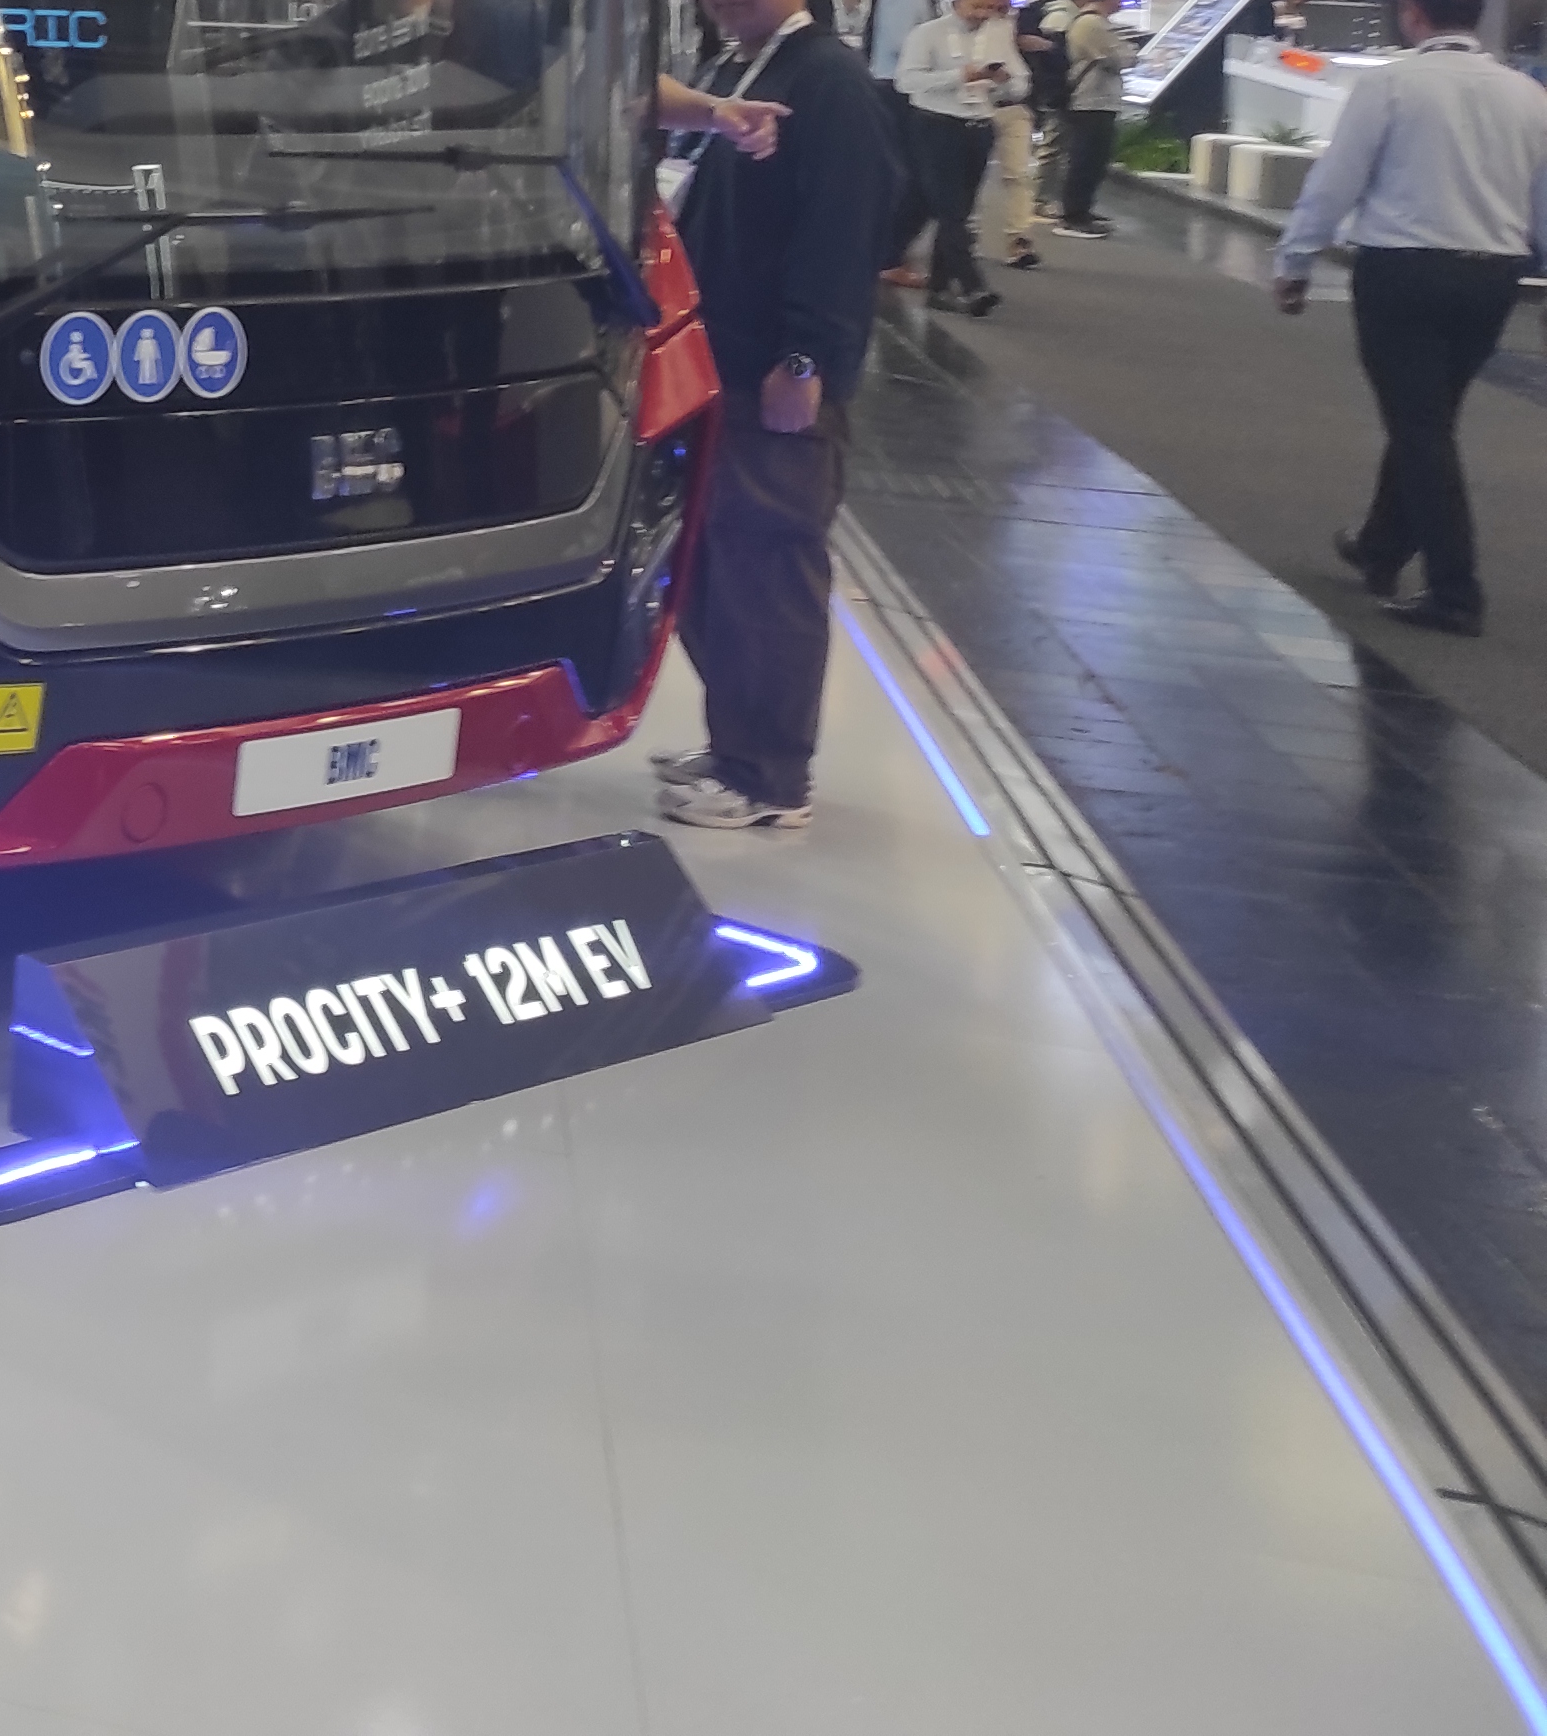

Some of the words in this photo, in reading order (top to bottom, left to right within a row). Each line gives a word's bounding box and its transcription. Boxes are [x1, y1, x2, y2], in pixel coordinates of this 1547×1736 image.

[325, 739, 380, 785] BMC
[188, 967, 467, 1096] PROCITY+
[463, 936, 589, 1026] 12M
[566, 919, 653, 1000] EV
